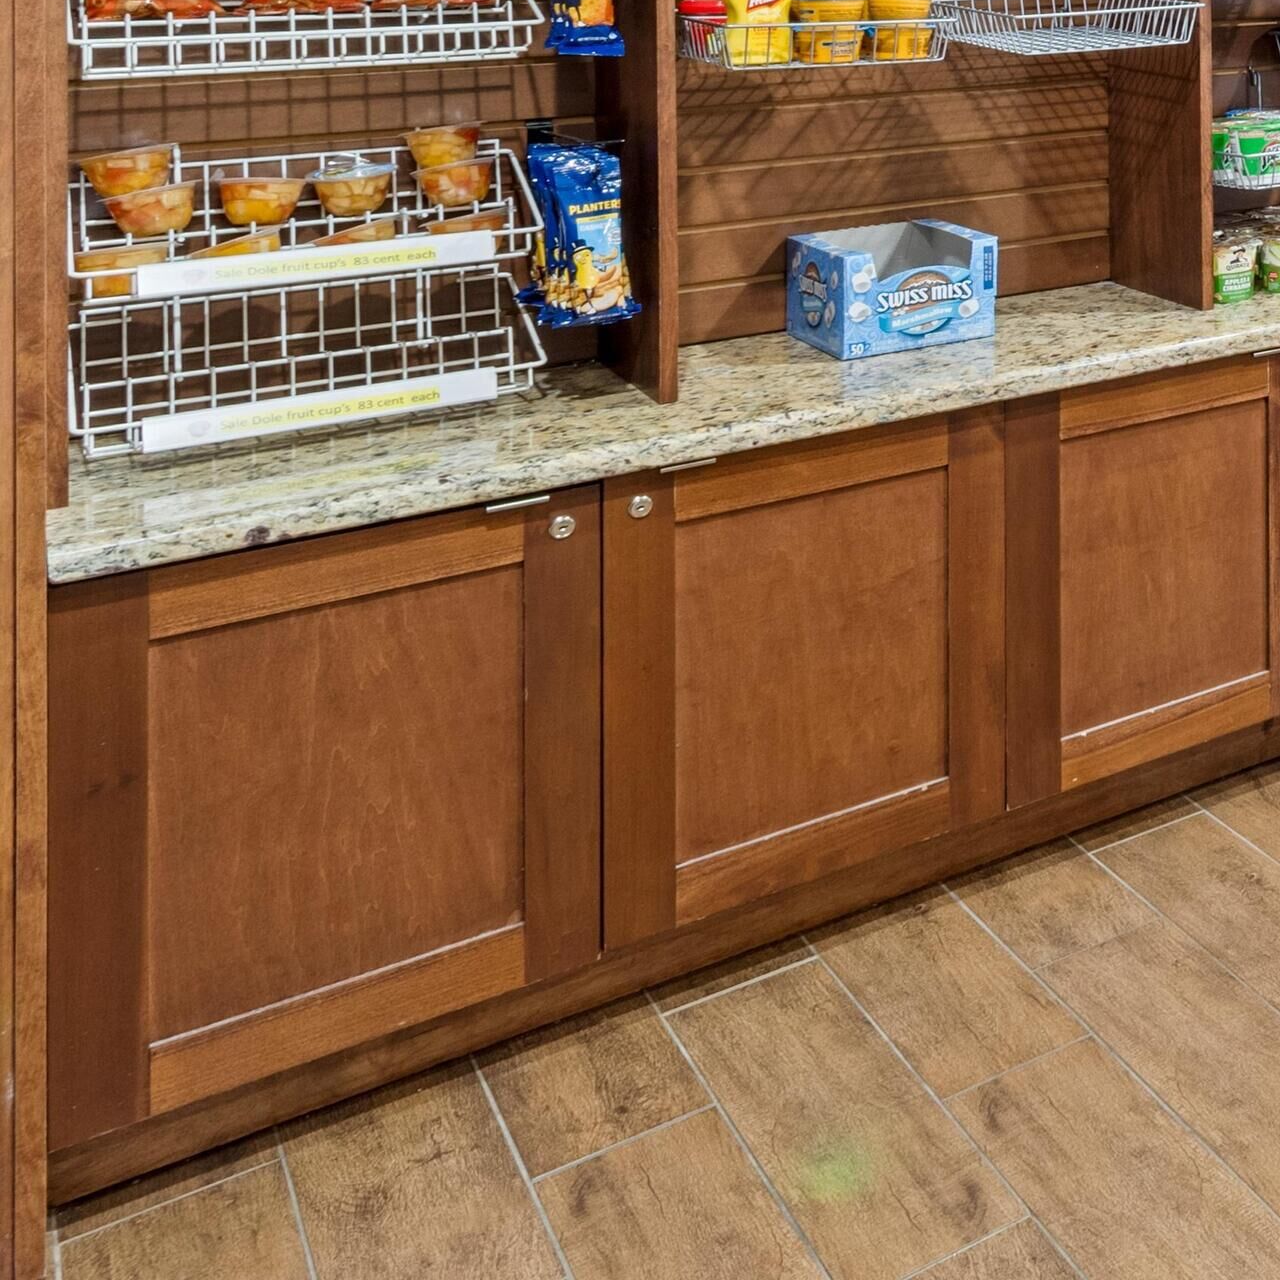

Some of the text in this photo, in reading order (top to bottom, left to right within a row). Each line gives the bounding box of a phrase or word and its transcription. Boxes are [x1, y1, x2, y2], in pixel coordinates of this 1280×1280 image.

[215, 249, 436, 280] Sale Dole fruit cup's 83 cent each
[876, 279, 973, 313] SWISS MISS
[850, 343, 865, 355] 50
[220, 390, 440, 431] Sale Dole fruit cup's 83 cent each
